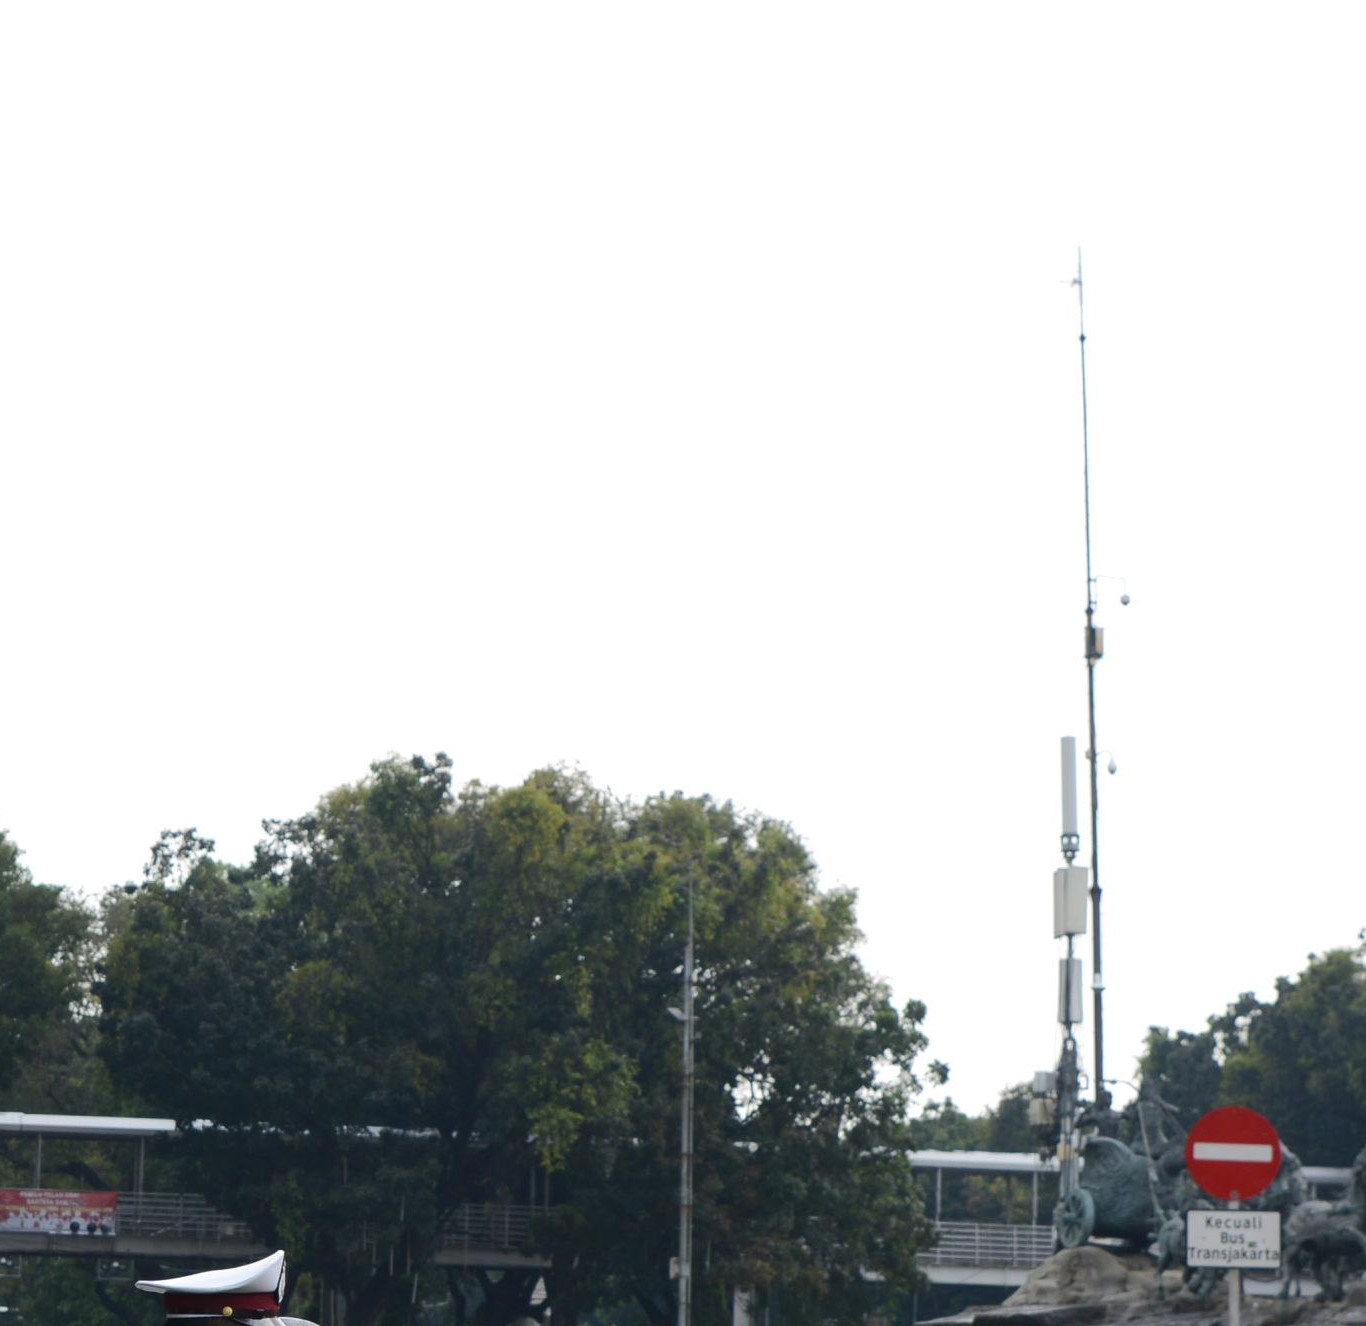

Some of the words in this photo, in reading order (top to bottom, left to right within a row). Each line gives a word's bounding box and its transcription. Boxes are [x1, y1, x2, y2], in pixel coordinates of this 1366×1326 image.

[1205, 1216, 1263, 1229] Kecuali
[1220, 1232, 1246, 1244] Bus
[1188, 1247, 1280, 1263] Transjakarta
